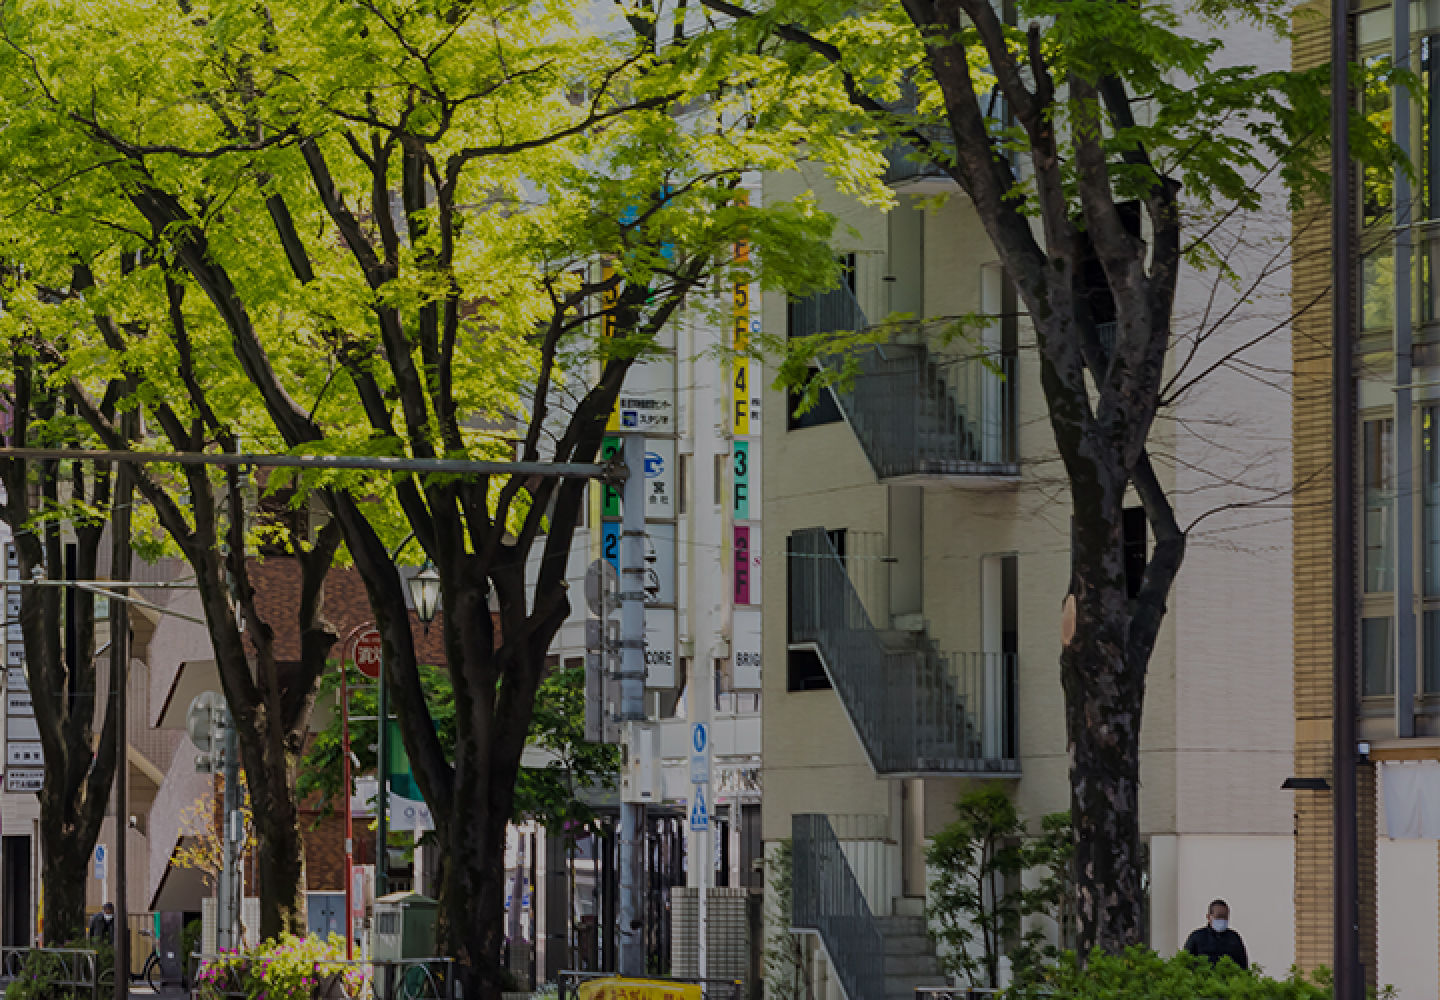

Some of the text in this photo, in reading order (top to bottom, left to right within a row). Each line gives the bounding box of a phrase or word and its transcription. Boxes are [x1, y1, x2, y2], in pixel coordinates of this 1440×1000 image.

[735, 282, 747, 342] 5F
[735, 366, 747, 426] 4F
[734, 451, 747, 510] 3F
[735, 536, 748, 595] 2F
